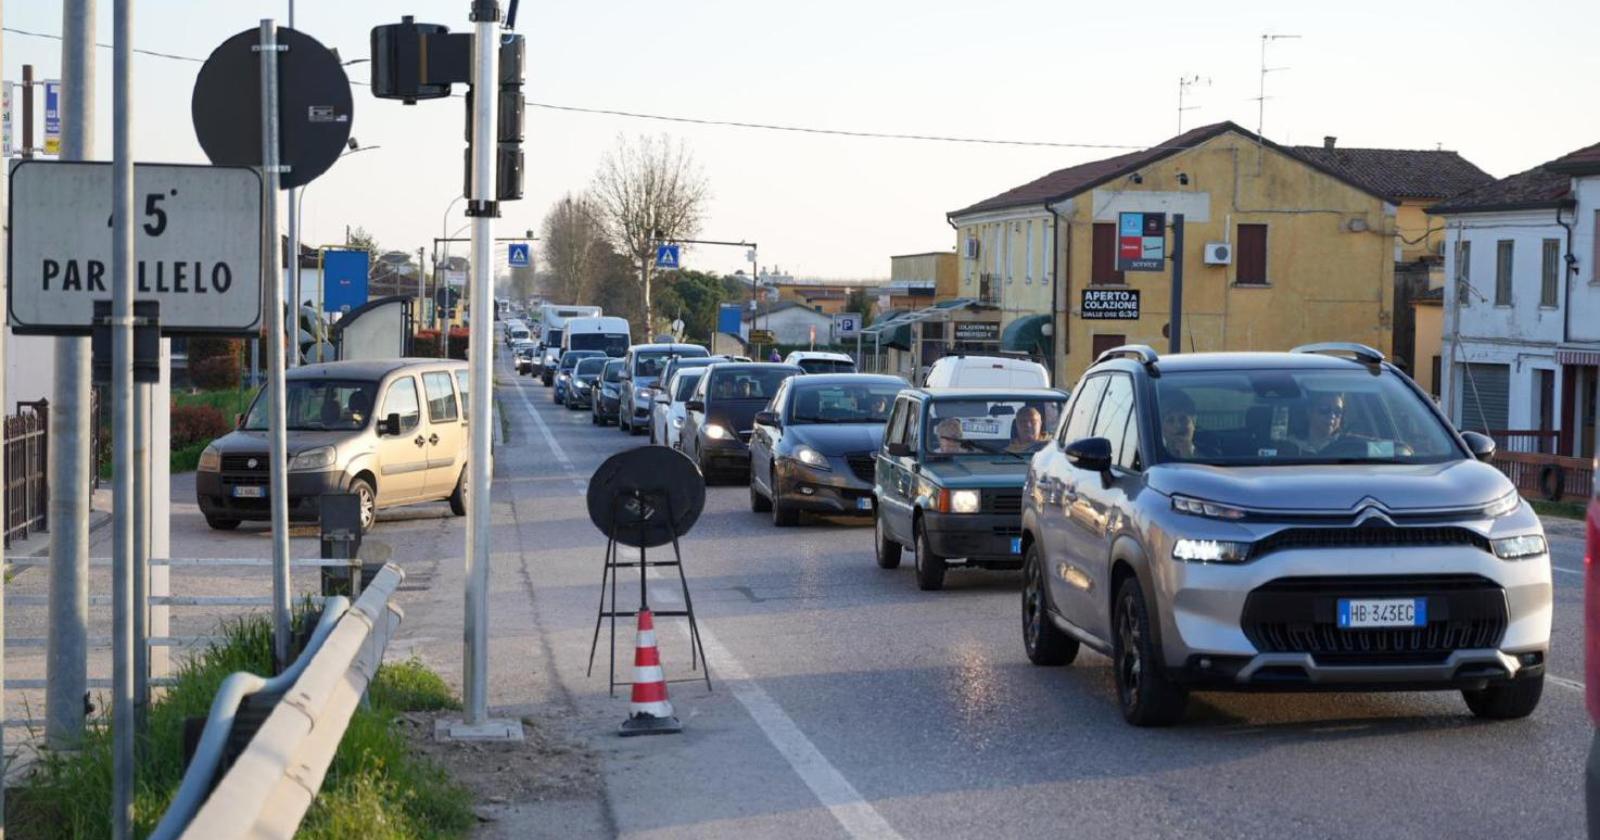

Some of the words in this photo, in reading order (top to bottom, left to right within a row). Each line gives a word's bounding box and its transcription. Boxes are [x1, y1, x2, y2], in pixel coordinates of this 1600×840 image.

[42, 259, 232, 294] PARLLELO
[1085, 291, 1130, 301] APERTO
[1084, 300, 1138, 309] COLAZIONE
